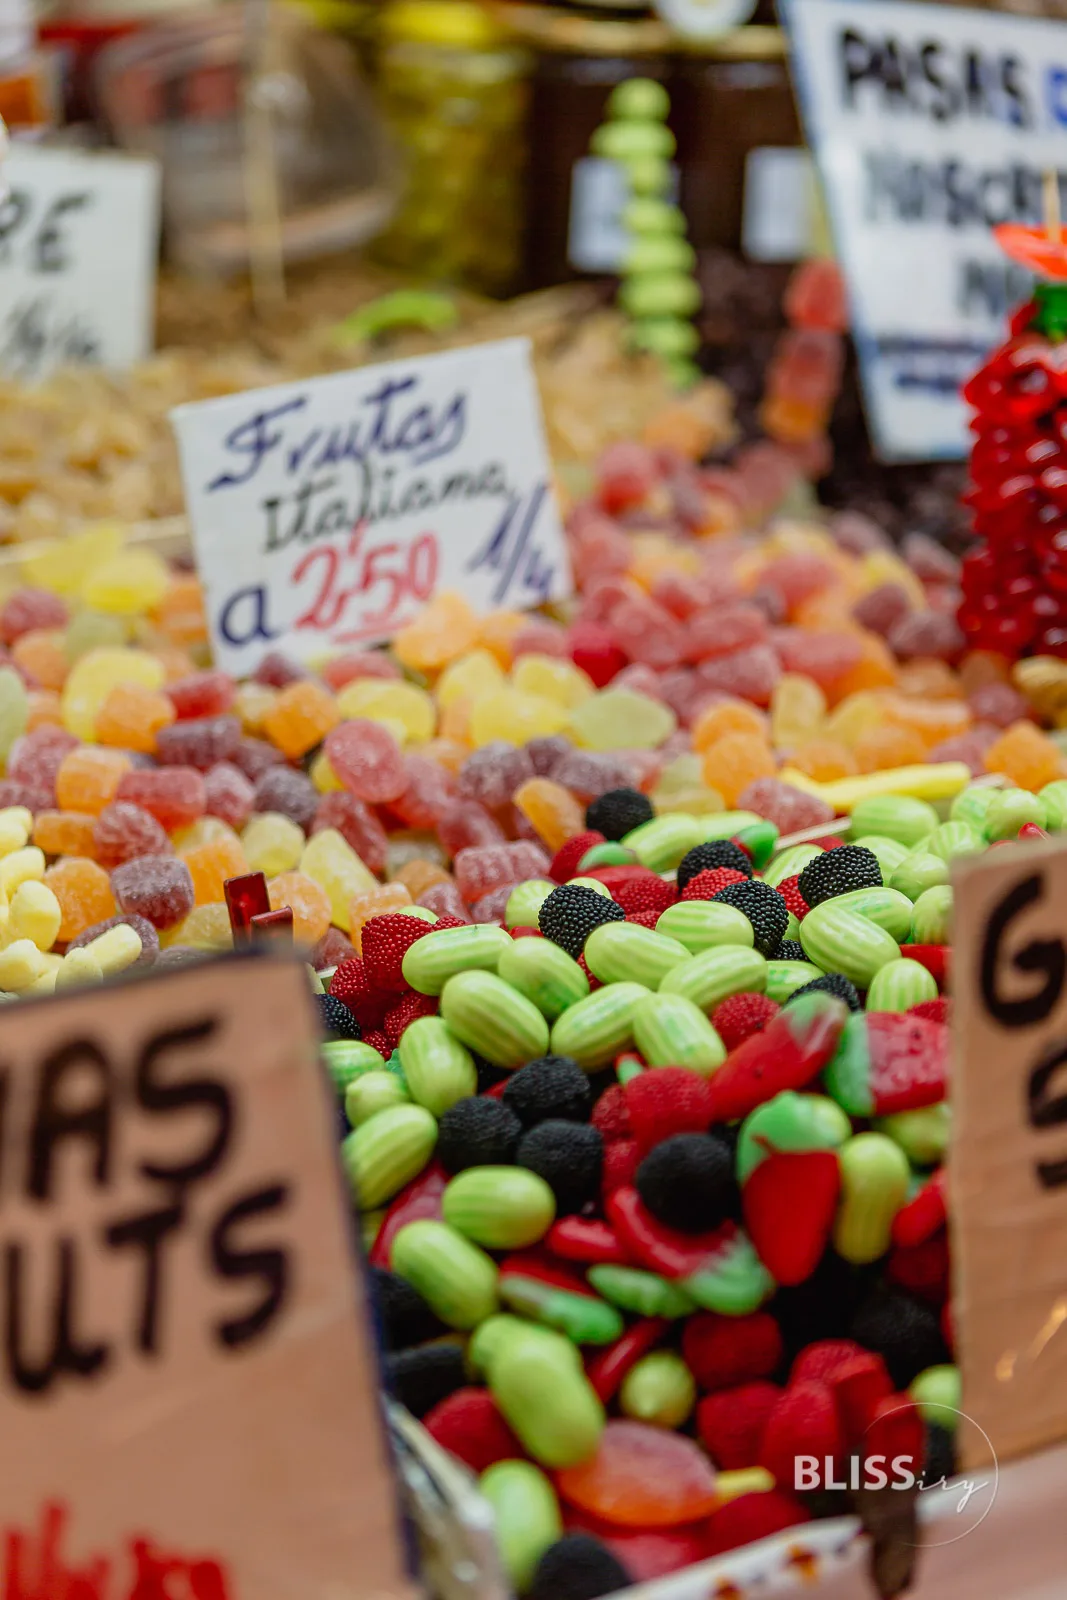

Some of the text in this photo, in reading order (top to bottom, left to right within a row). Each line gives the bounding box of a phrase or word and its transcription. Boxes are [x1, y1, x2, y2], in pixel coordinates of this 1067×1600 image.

[839, 26, 1030, 130] PASAS
[206, 376, 466, 491] Frutas
[218, 583, 278, 646] a
[0, 1019, 236, 1205] AS
[4, 1180, 292, 1396] UTS
